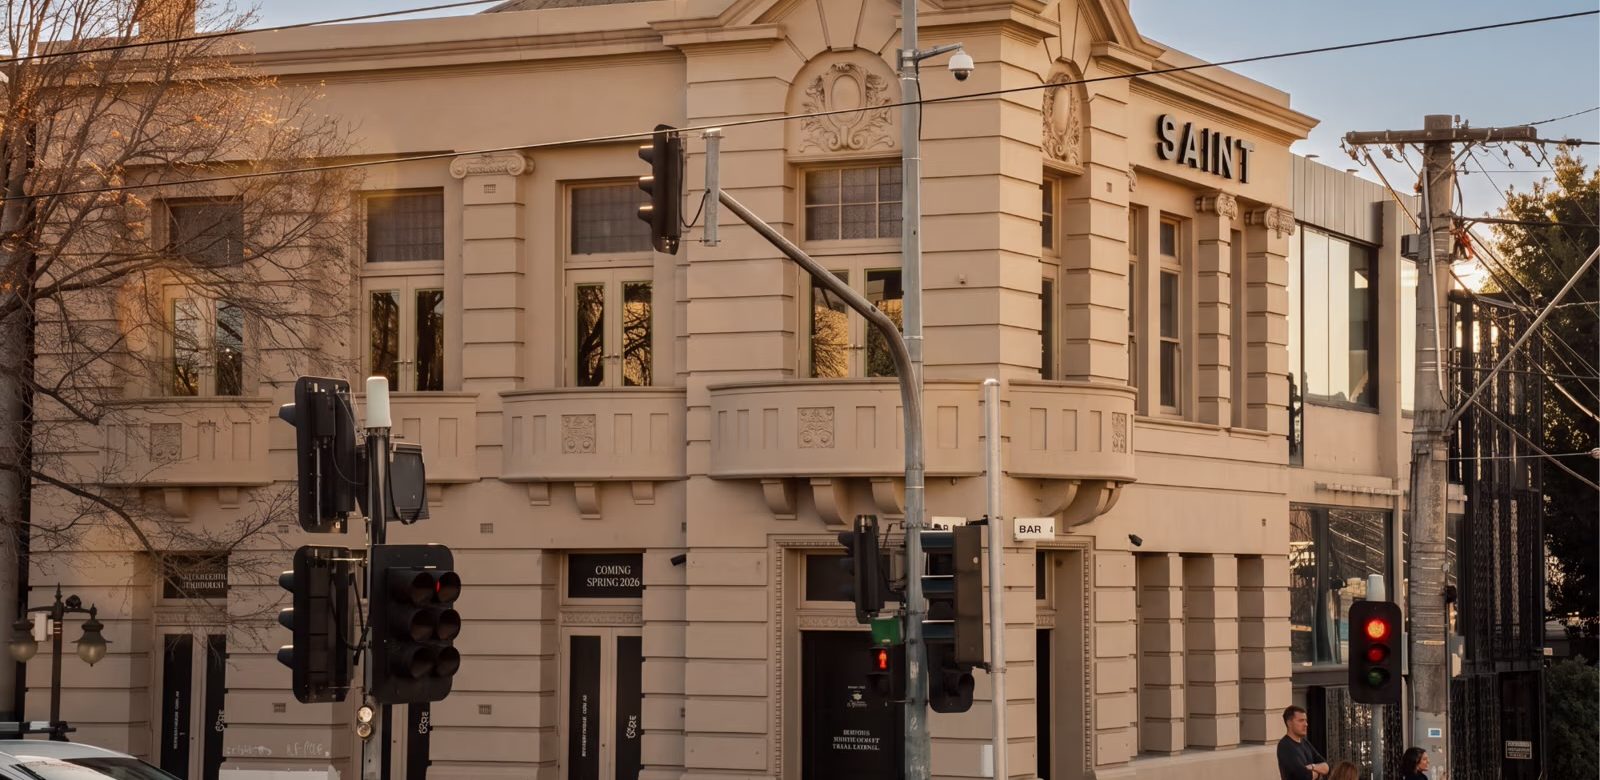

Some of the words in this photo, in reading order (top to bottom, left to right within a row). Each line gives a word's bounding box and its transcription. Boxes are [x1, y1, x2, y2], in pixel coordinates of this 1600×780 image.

[1156, 113, 1255, 184] SAINT
[1019, 525, 1041, 533] BAR
[595, 565, 631, 575] COMING
[586, 577, 618, 587] SPRING
[620, 577, 640, 587] 2026
